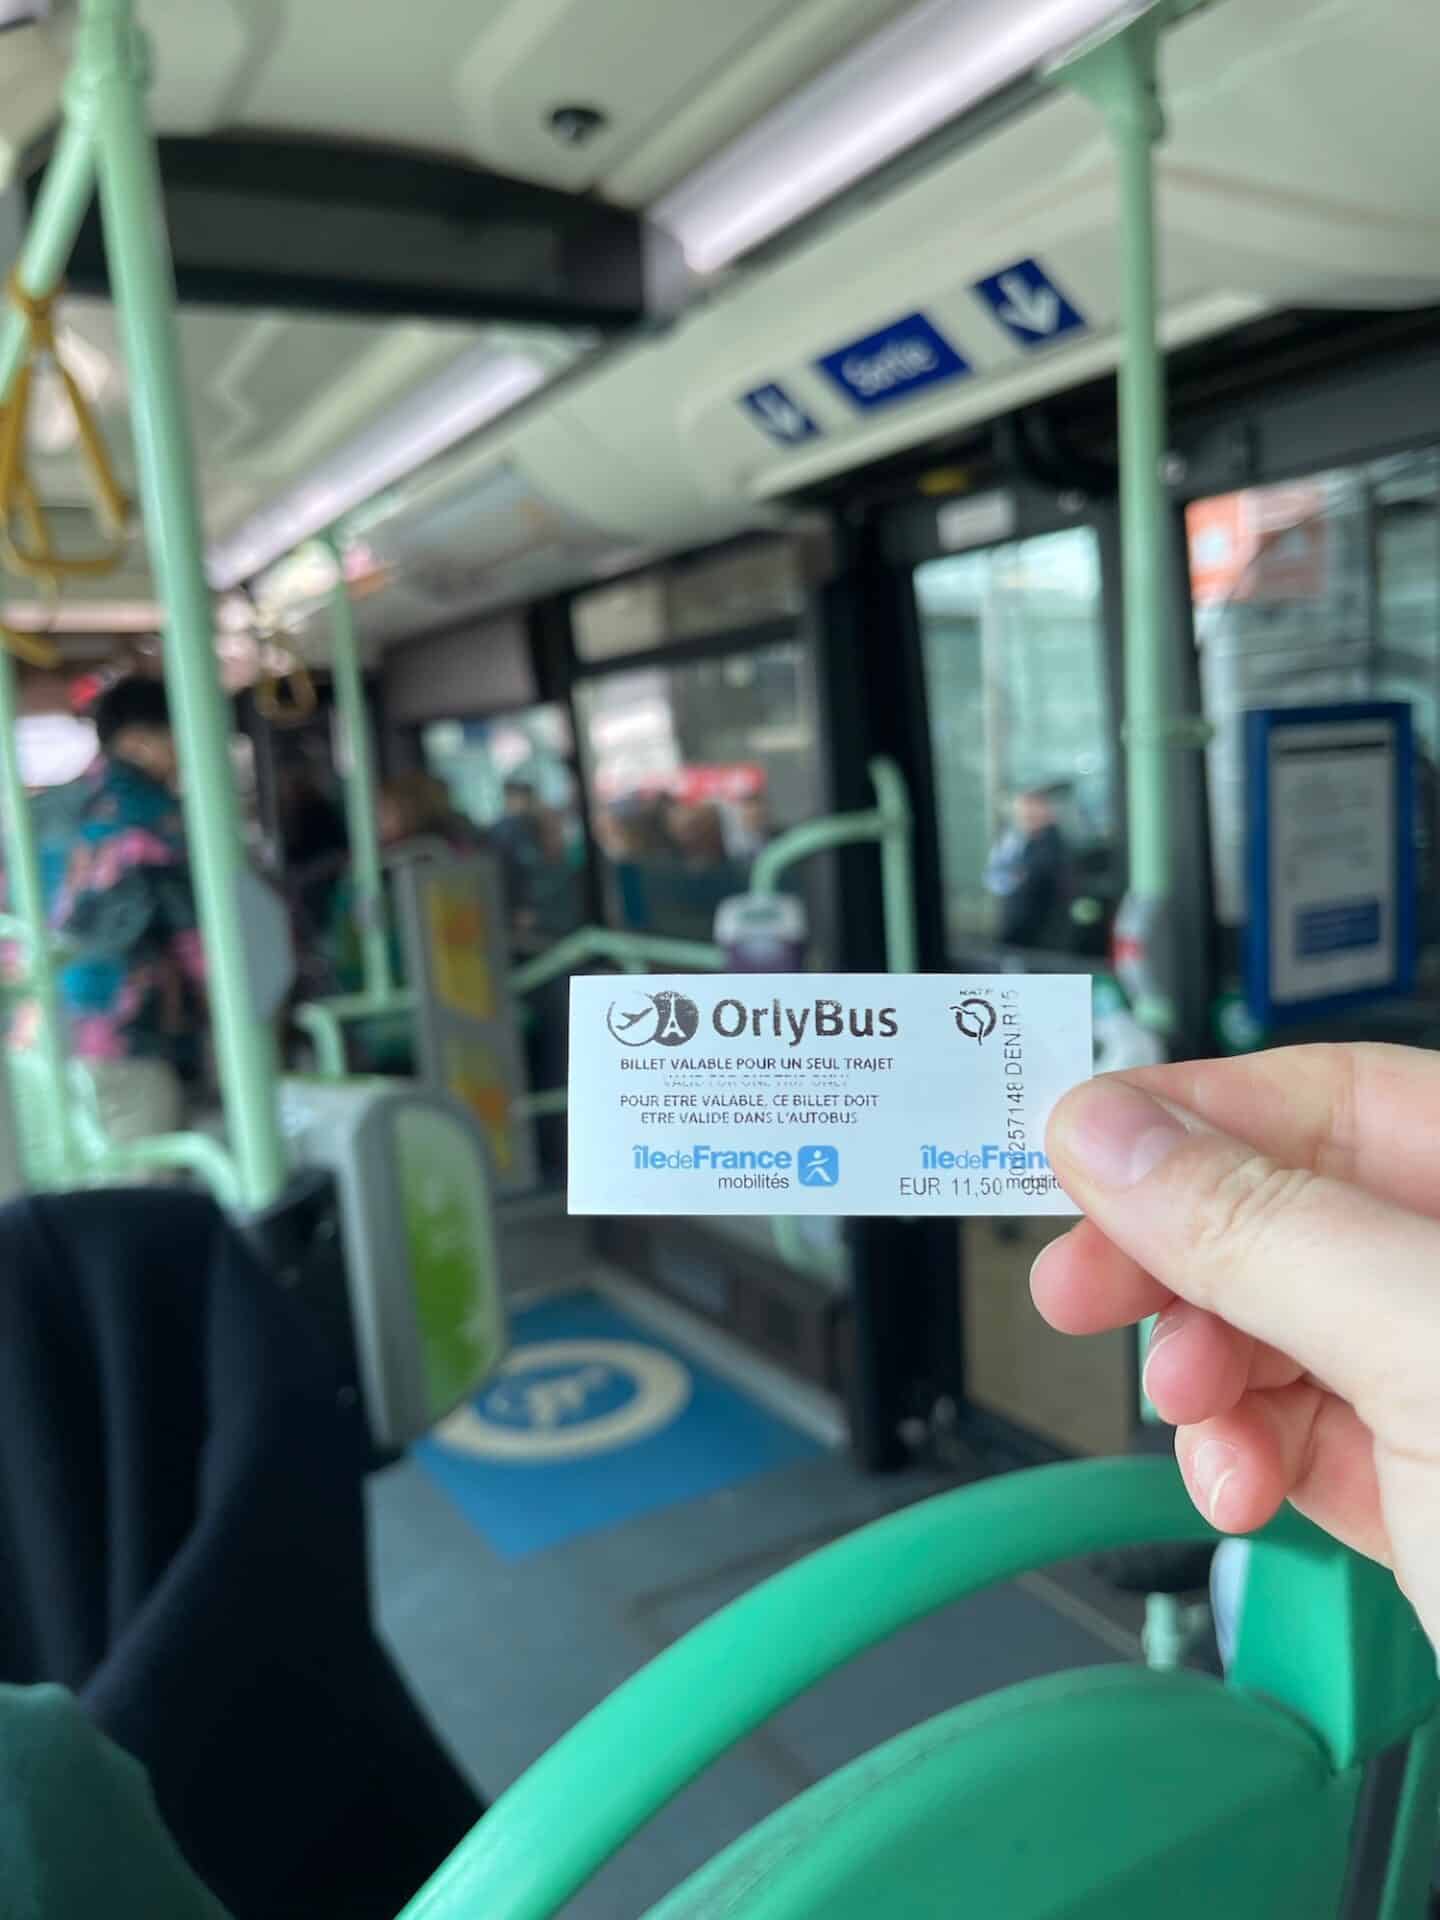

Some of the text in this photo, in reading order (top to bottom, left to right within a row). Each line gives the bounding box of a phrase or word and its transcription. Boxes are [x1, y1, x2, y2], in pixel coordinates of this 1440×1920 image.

[712, 999, 898, 1047] OrlyBus
[620, 1058, 893, 1072] BILLET VALABLE POUR UN SEUL TRAJET
[620, 1095, 880, 1108] POUR ETRE VALABLE, CE BILLET DOIT
[641, 1112, 857, 1123] ETRE VALIDE DANS L'AUTOBUS
[633, 1145, 792, 1169] îledeFrance
[920, 1145, 1052, 1169] îledeFran
[718, 1172, 789, 1189] mobilités
[900, 1177, 940, 1195] EUR
[952, 1177, 1002, 1197] 11,50
